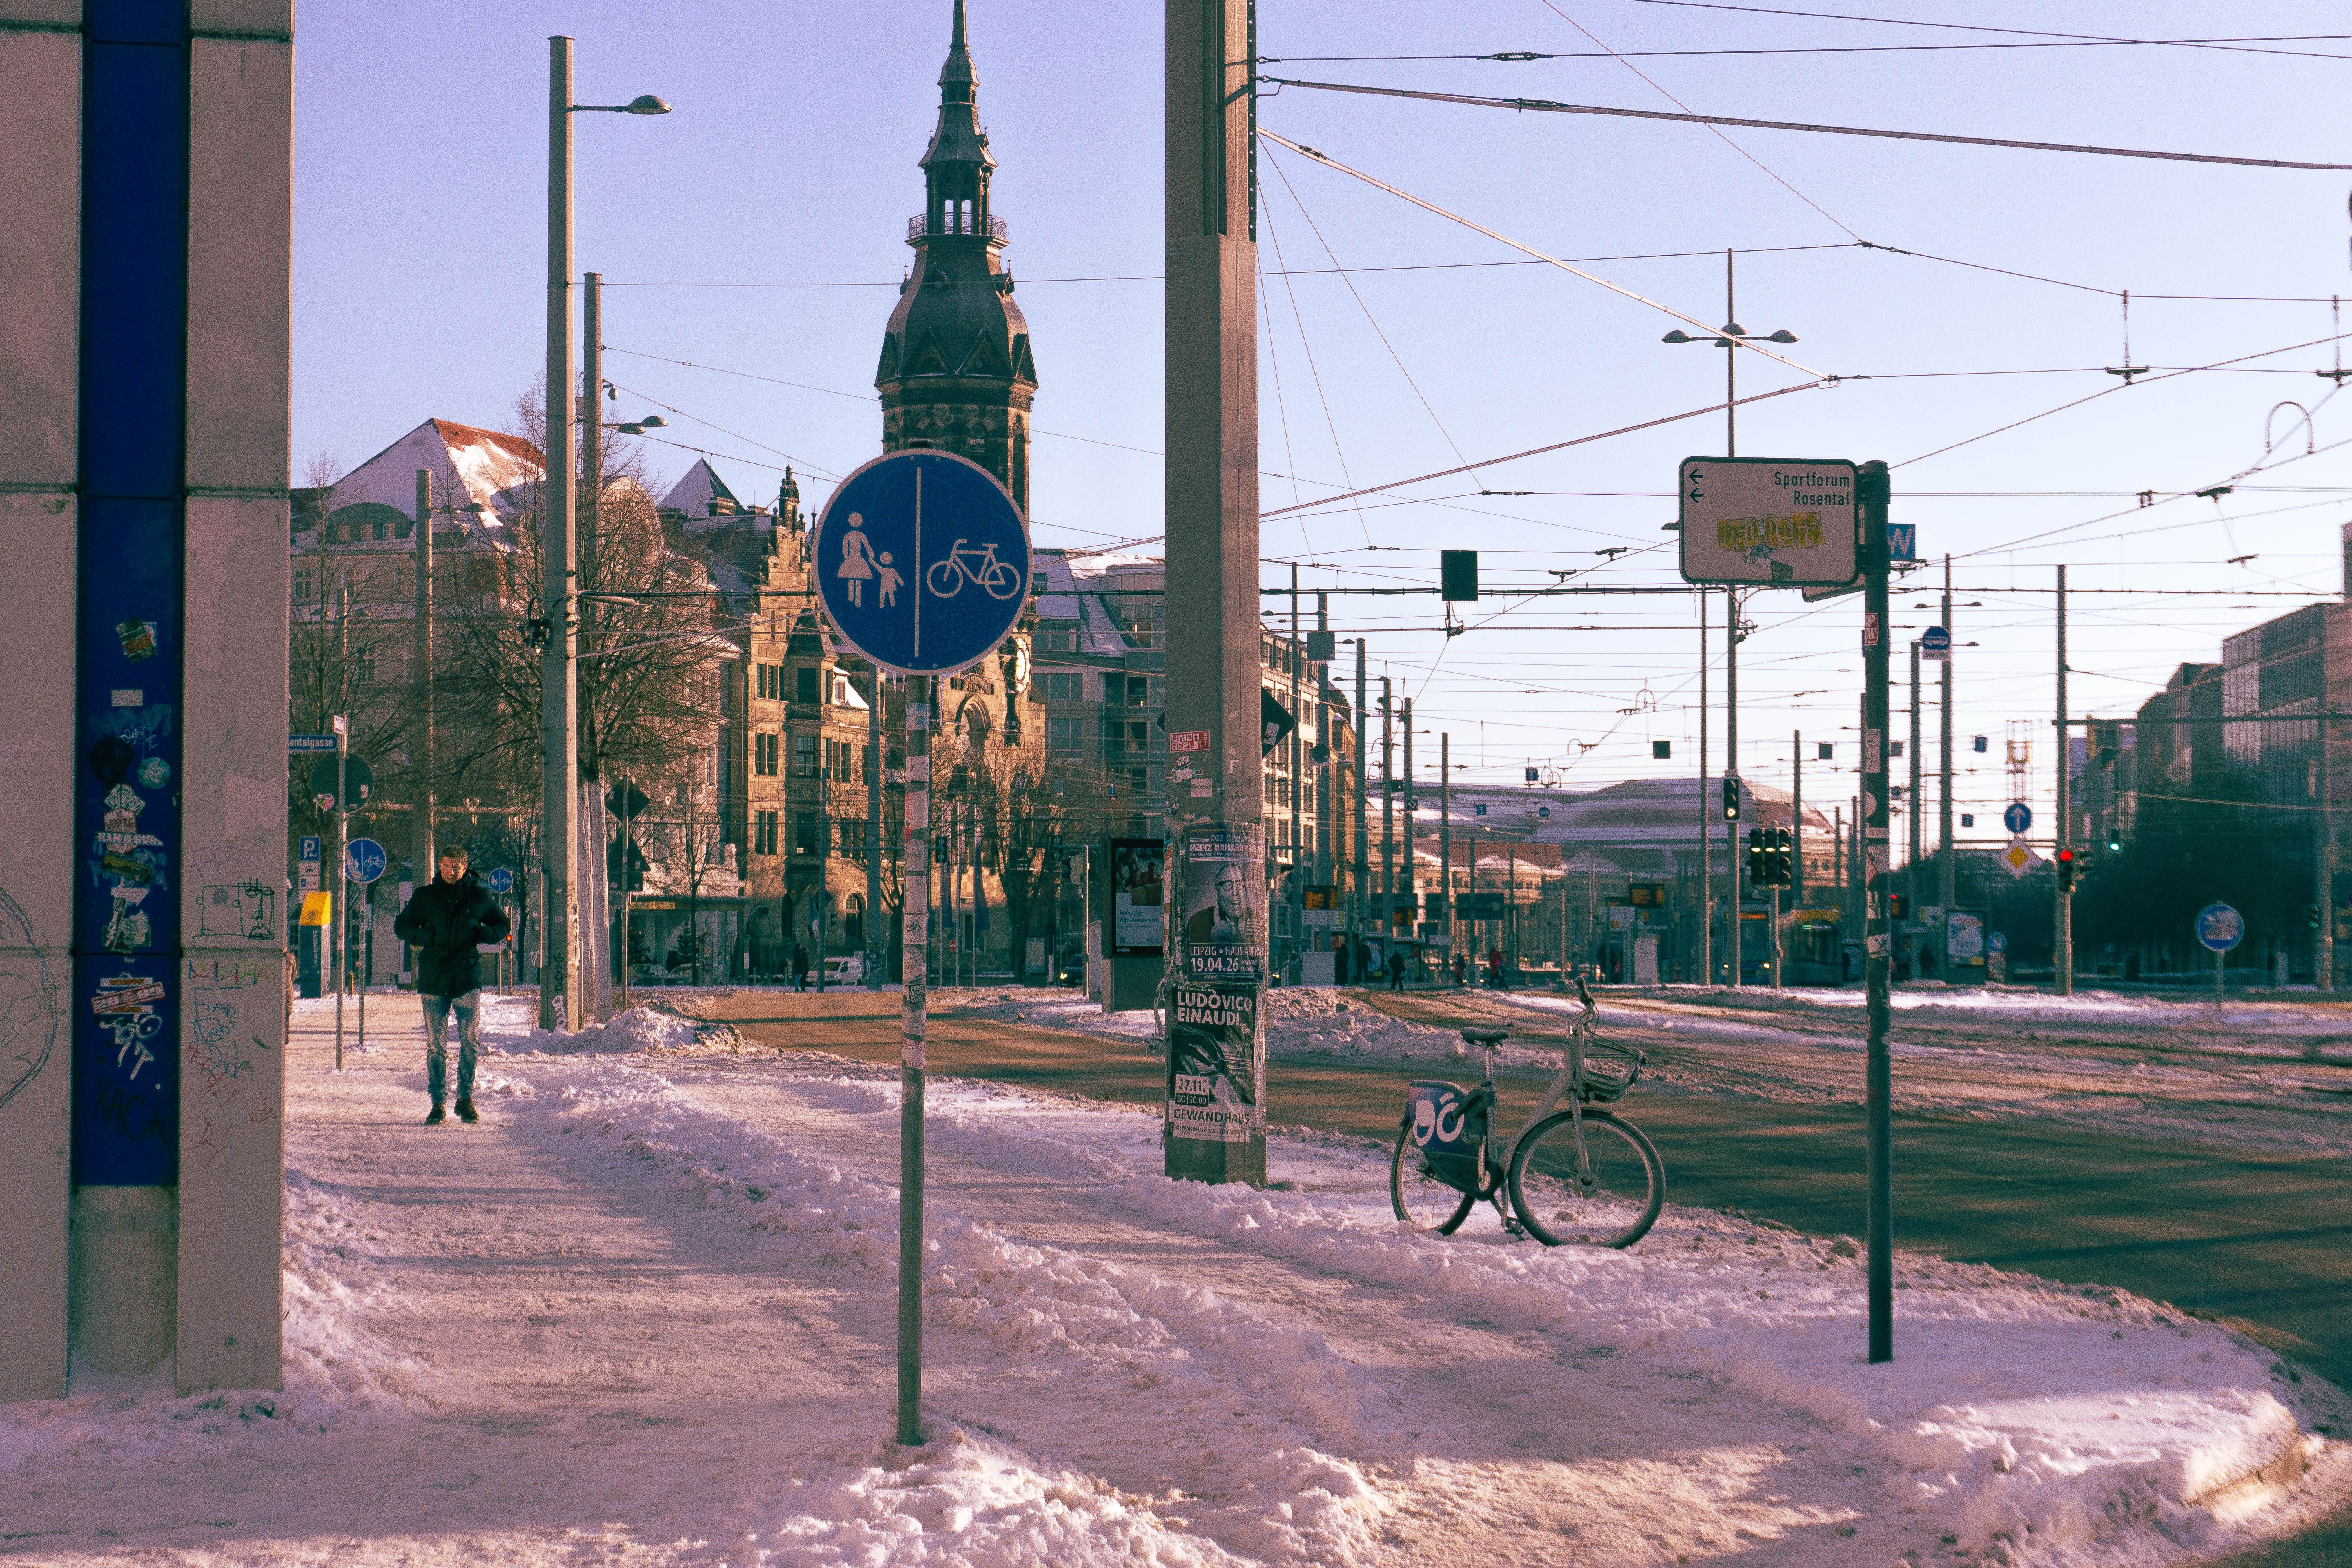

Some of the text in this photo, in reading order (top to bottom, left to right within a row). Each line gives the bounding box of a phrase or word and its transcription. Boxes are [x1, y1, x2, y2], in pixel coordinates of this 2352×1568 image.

[1774, 472, 1850, 489] Sportforum
[1793, 491, 1850, 506] Rosental
[289, 737, 333, 749] entalgasse
[1171, 733, 1199, 742] UNION
[1171, 741, 1202, 751] BERLIN
[304, 839, 315, 858] P
[1190, 946, 1217, 956] LEIPZIG
[1225, 946, 1243, 956] HAUS
[1191, 958, 1239, 972] 19.04.26
[1178, 991, 1252, 1012] LUDOVICO
[1178, 1007, 1239, 1026] EINAUDI
[1189, 1096, 1207, 1105] 20.00
[1173, 1109, 1249, 1124] GEWANDHAUS
[1176, 1125, 1216, 1134] GEWANDHAUS.DE
